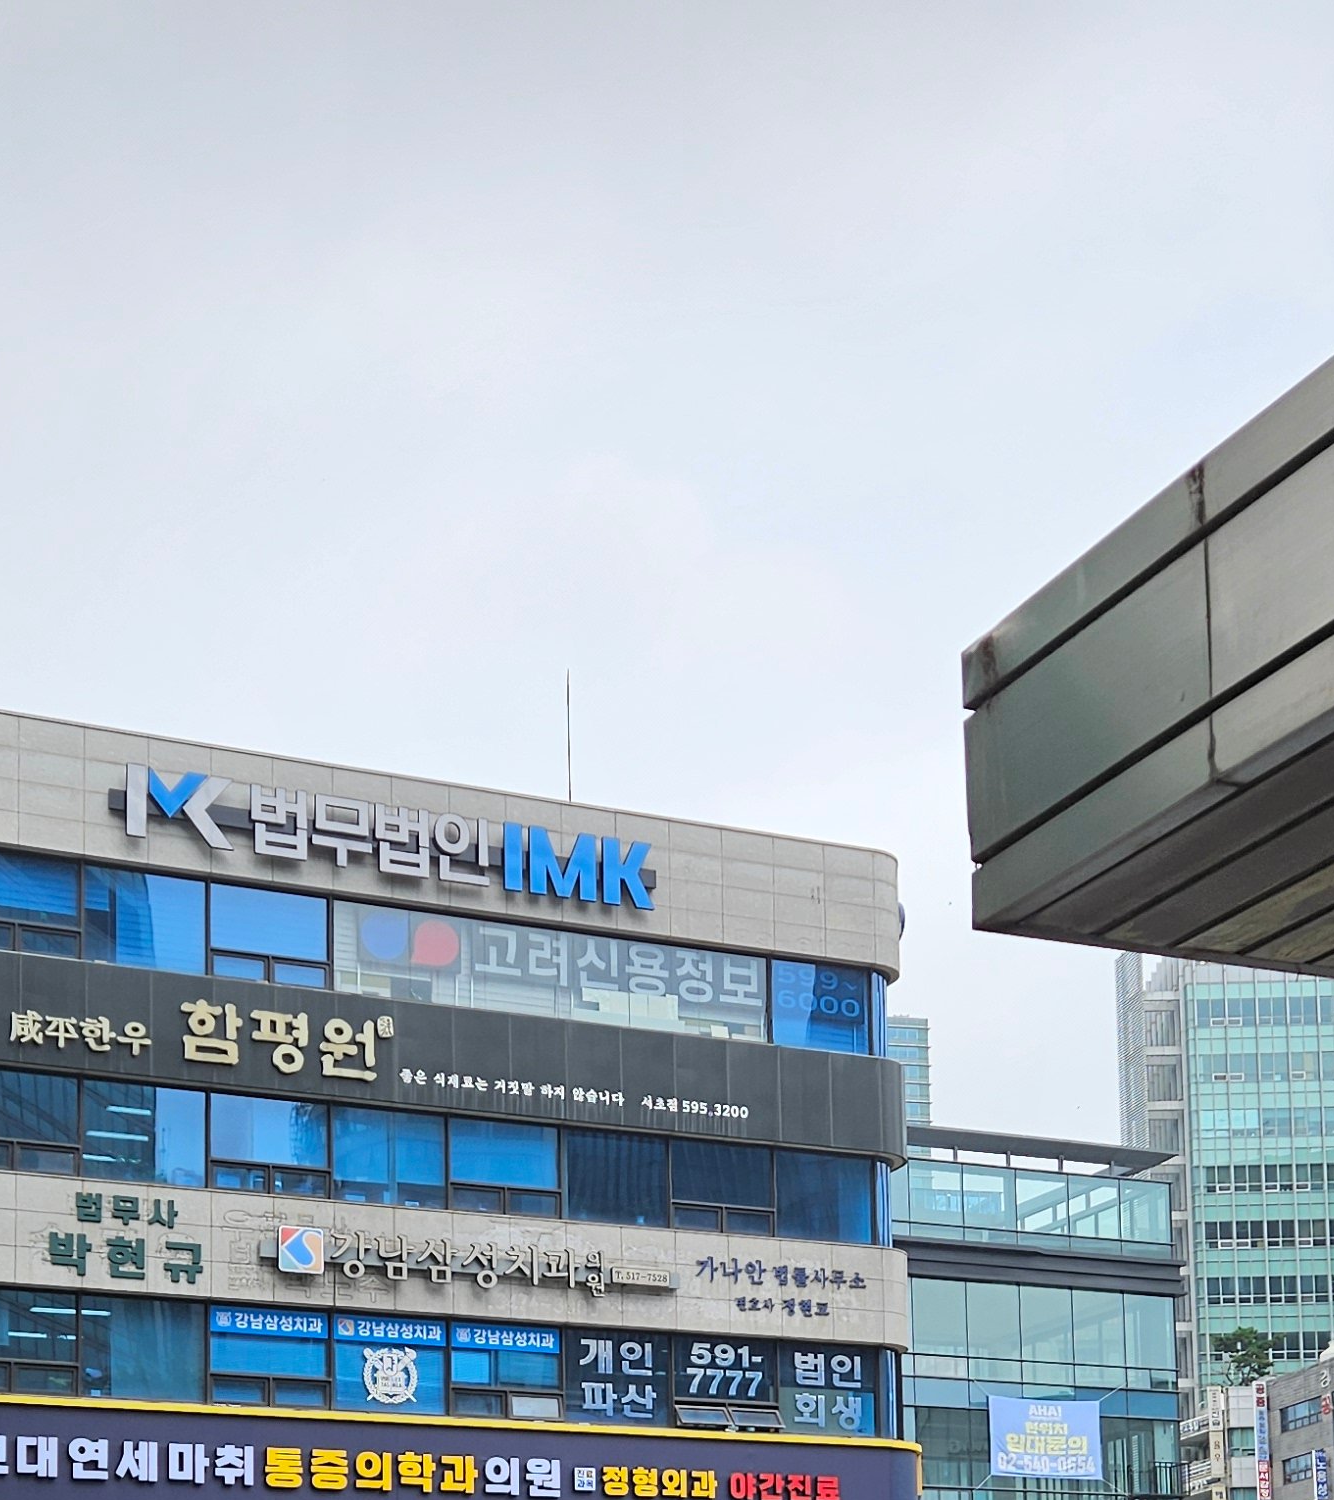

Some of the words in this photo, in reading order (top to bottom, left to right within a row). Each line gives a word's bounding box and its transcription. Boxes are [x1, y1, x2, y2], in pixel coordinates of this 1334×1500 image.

[249, 782, 491, 887] 법무법인
[502, 820, 656, 911] IMK
[474, 924, 765, 1008] 고려신용정보
[775, 988, 861, 1019] 6000
[179, 998, 379, 1082] 함평원
[433, 1071, 489, 1092] 식재료는
[493, 1078, 536, 1097] 거짓말
[540, 1083, 566, 1101] 하지
[571, 1087, 626, 1108] 않습니다
[640, 1095, 679, 1113] 서초점
[75, 1191, 180, 1229] 법무사
[47, 1232, 204, 1285] 박현규
[331, 1228, 580, 1291] 강남삼성치과
[695, 1255, 767, 1286] 가나안
[772, 1264, 867, 1290] 법률사무소
[625, 1270, 669, 1284] 517-7528
[734, 1296, 776, 1313] 변호사
[234, 1311, 323, 1335] 강남삼성치과
[357, 1319, 442, 1342] 강남삼성치과
[472, 1327, 555, 1350] 강남삼성치과
[578, 1337, 654, 1377] 개인
[689, 1342, 763, 1368] 591-
[793, 1352, 863, 1390] 법인
[685, 1367, 763, 1398] 7777
[580, 1380, 657, 1421] 파산
[793, 1392, 864, 1432] 회생
[1005, 1433, 1088, 1456] 임대문의
[1025, 1421, 1069, 1435] 현위치
[601, 1465, 719, 1500] 정형외과
